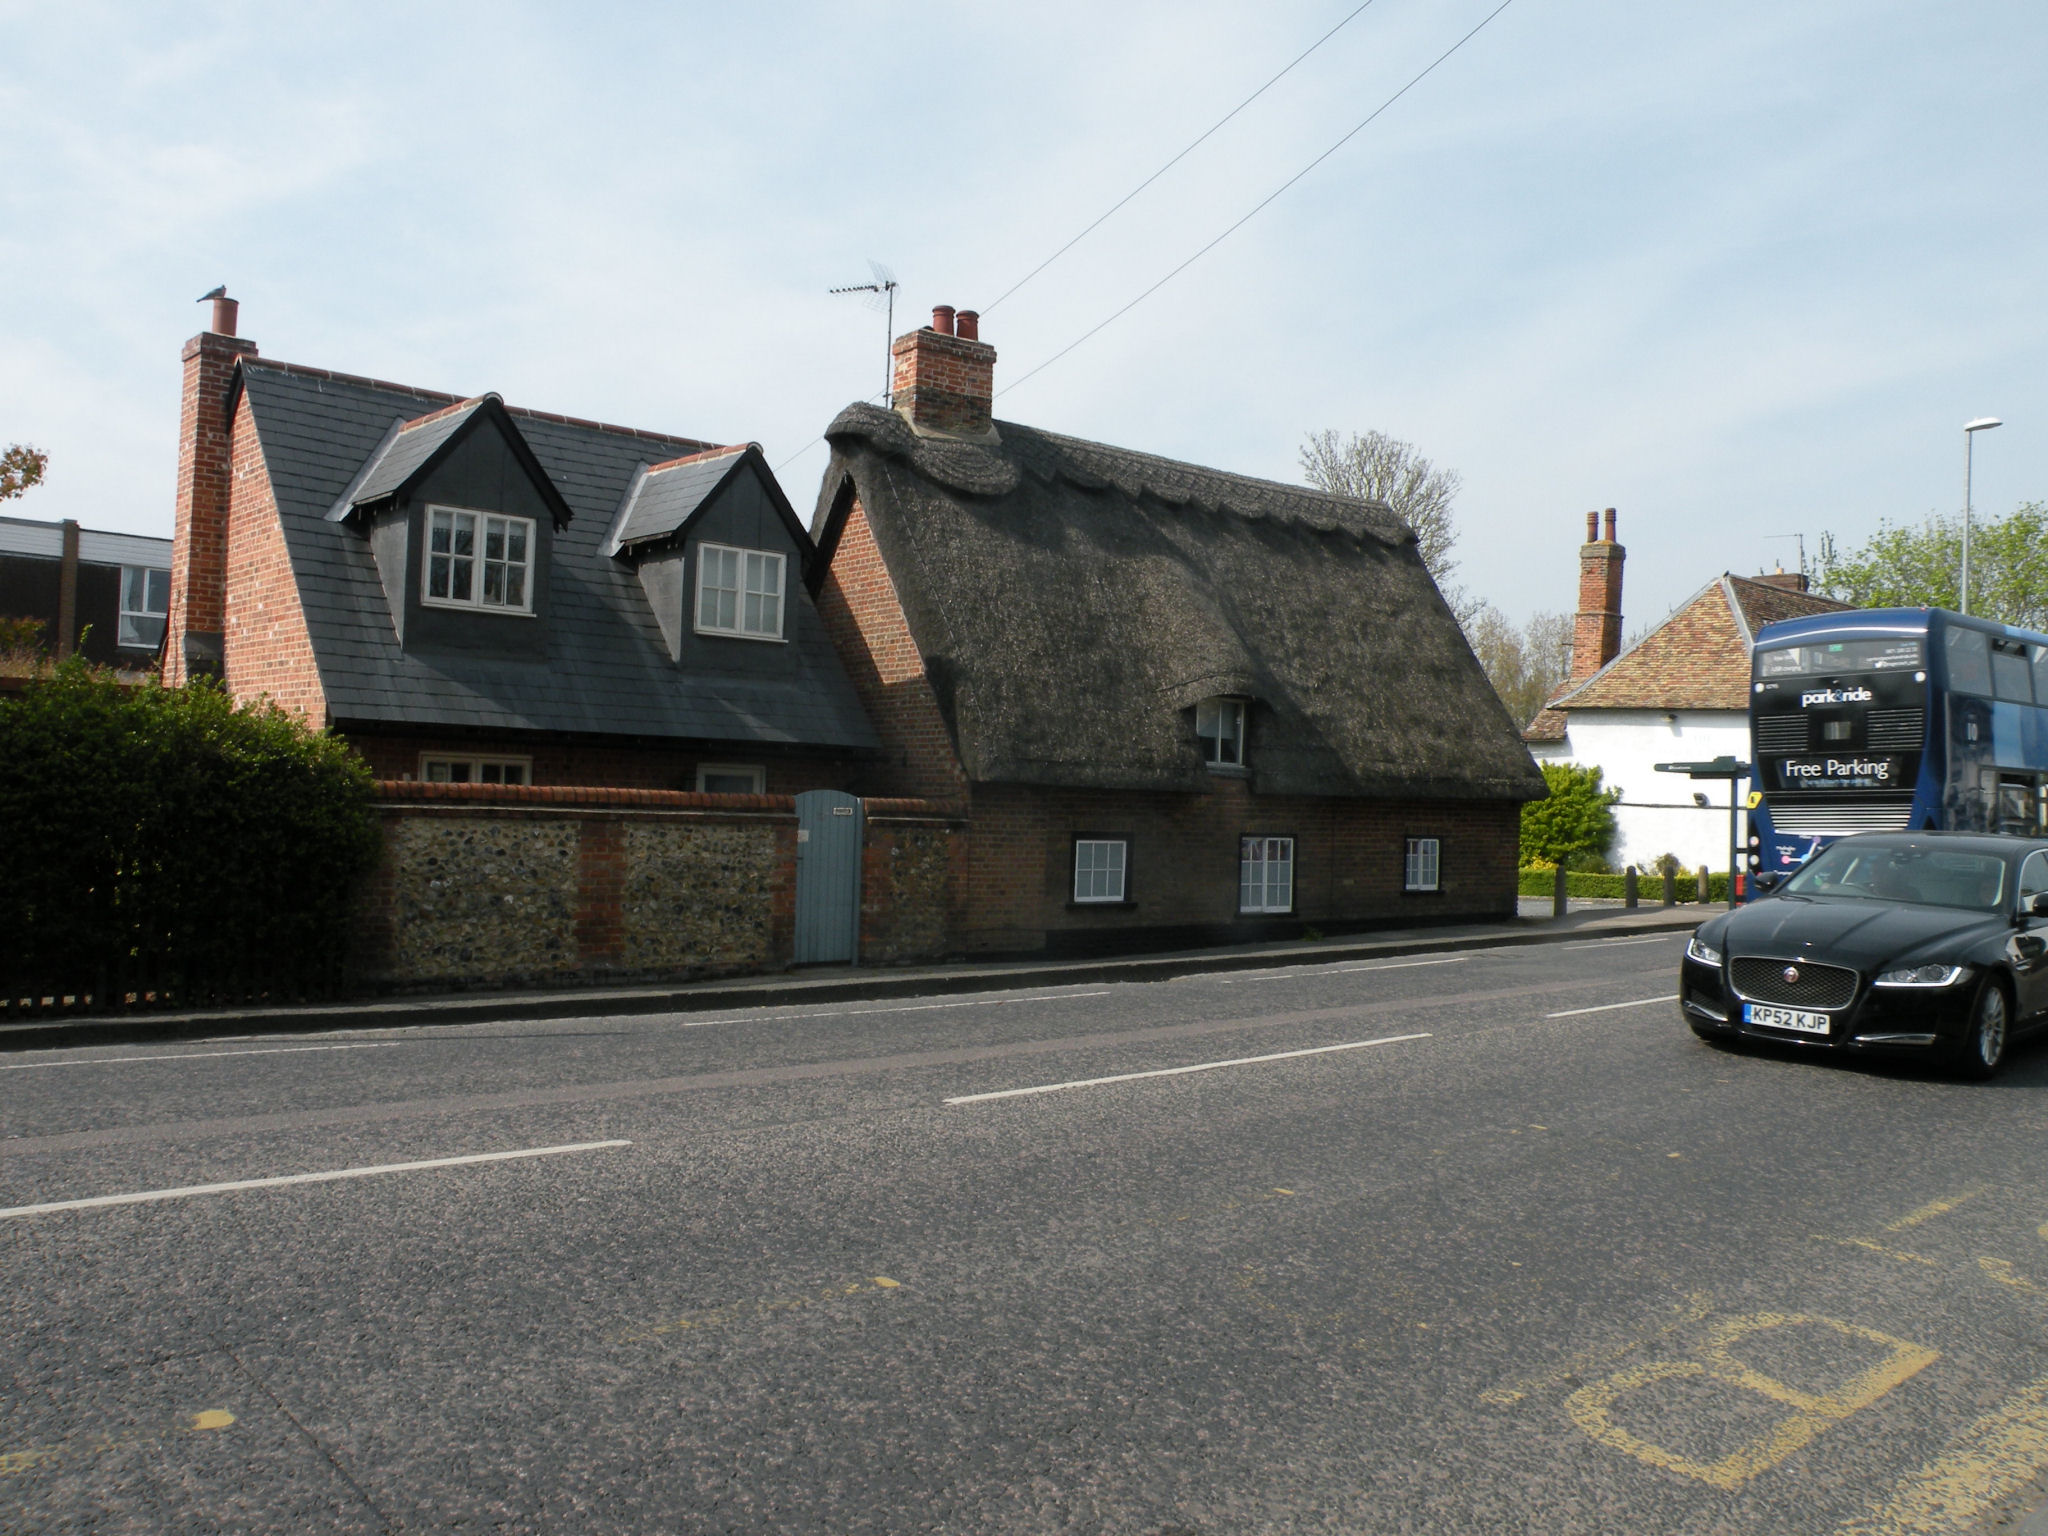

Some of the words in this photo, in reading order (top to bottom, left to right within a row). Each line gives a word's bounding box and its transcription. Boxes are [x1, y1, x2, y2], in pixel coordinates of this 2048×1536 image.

[1802, 686, 1873, 708] park&ride
[1785, 760, 1822, 777] Free
[1753, 1007, 1793, 1027] KP52
[1796, 1013, 1827, 1030] KJP
